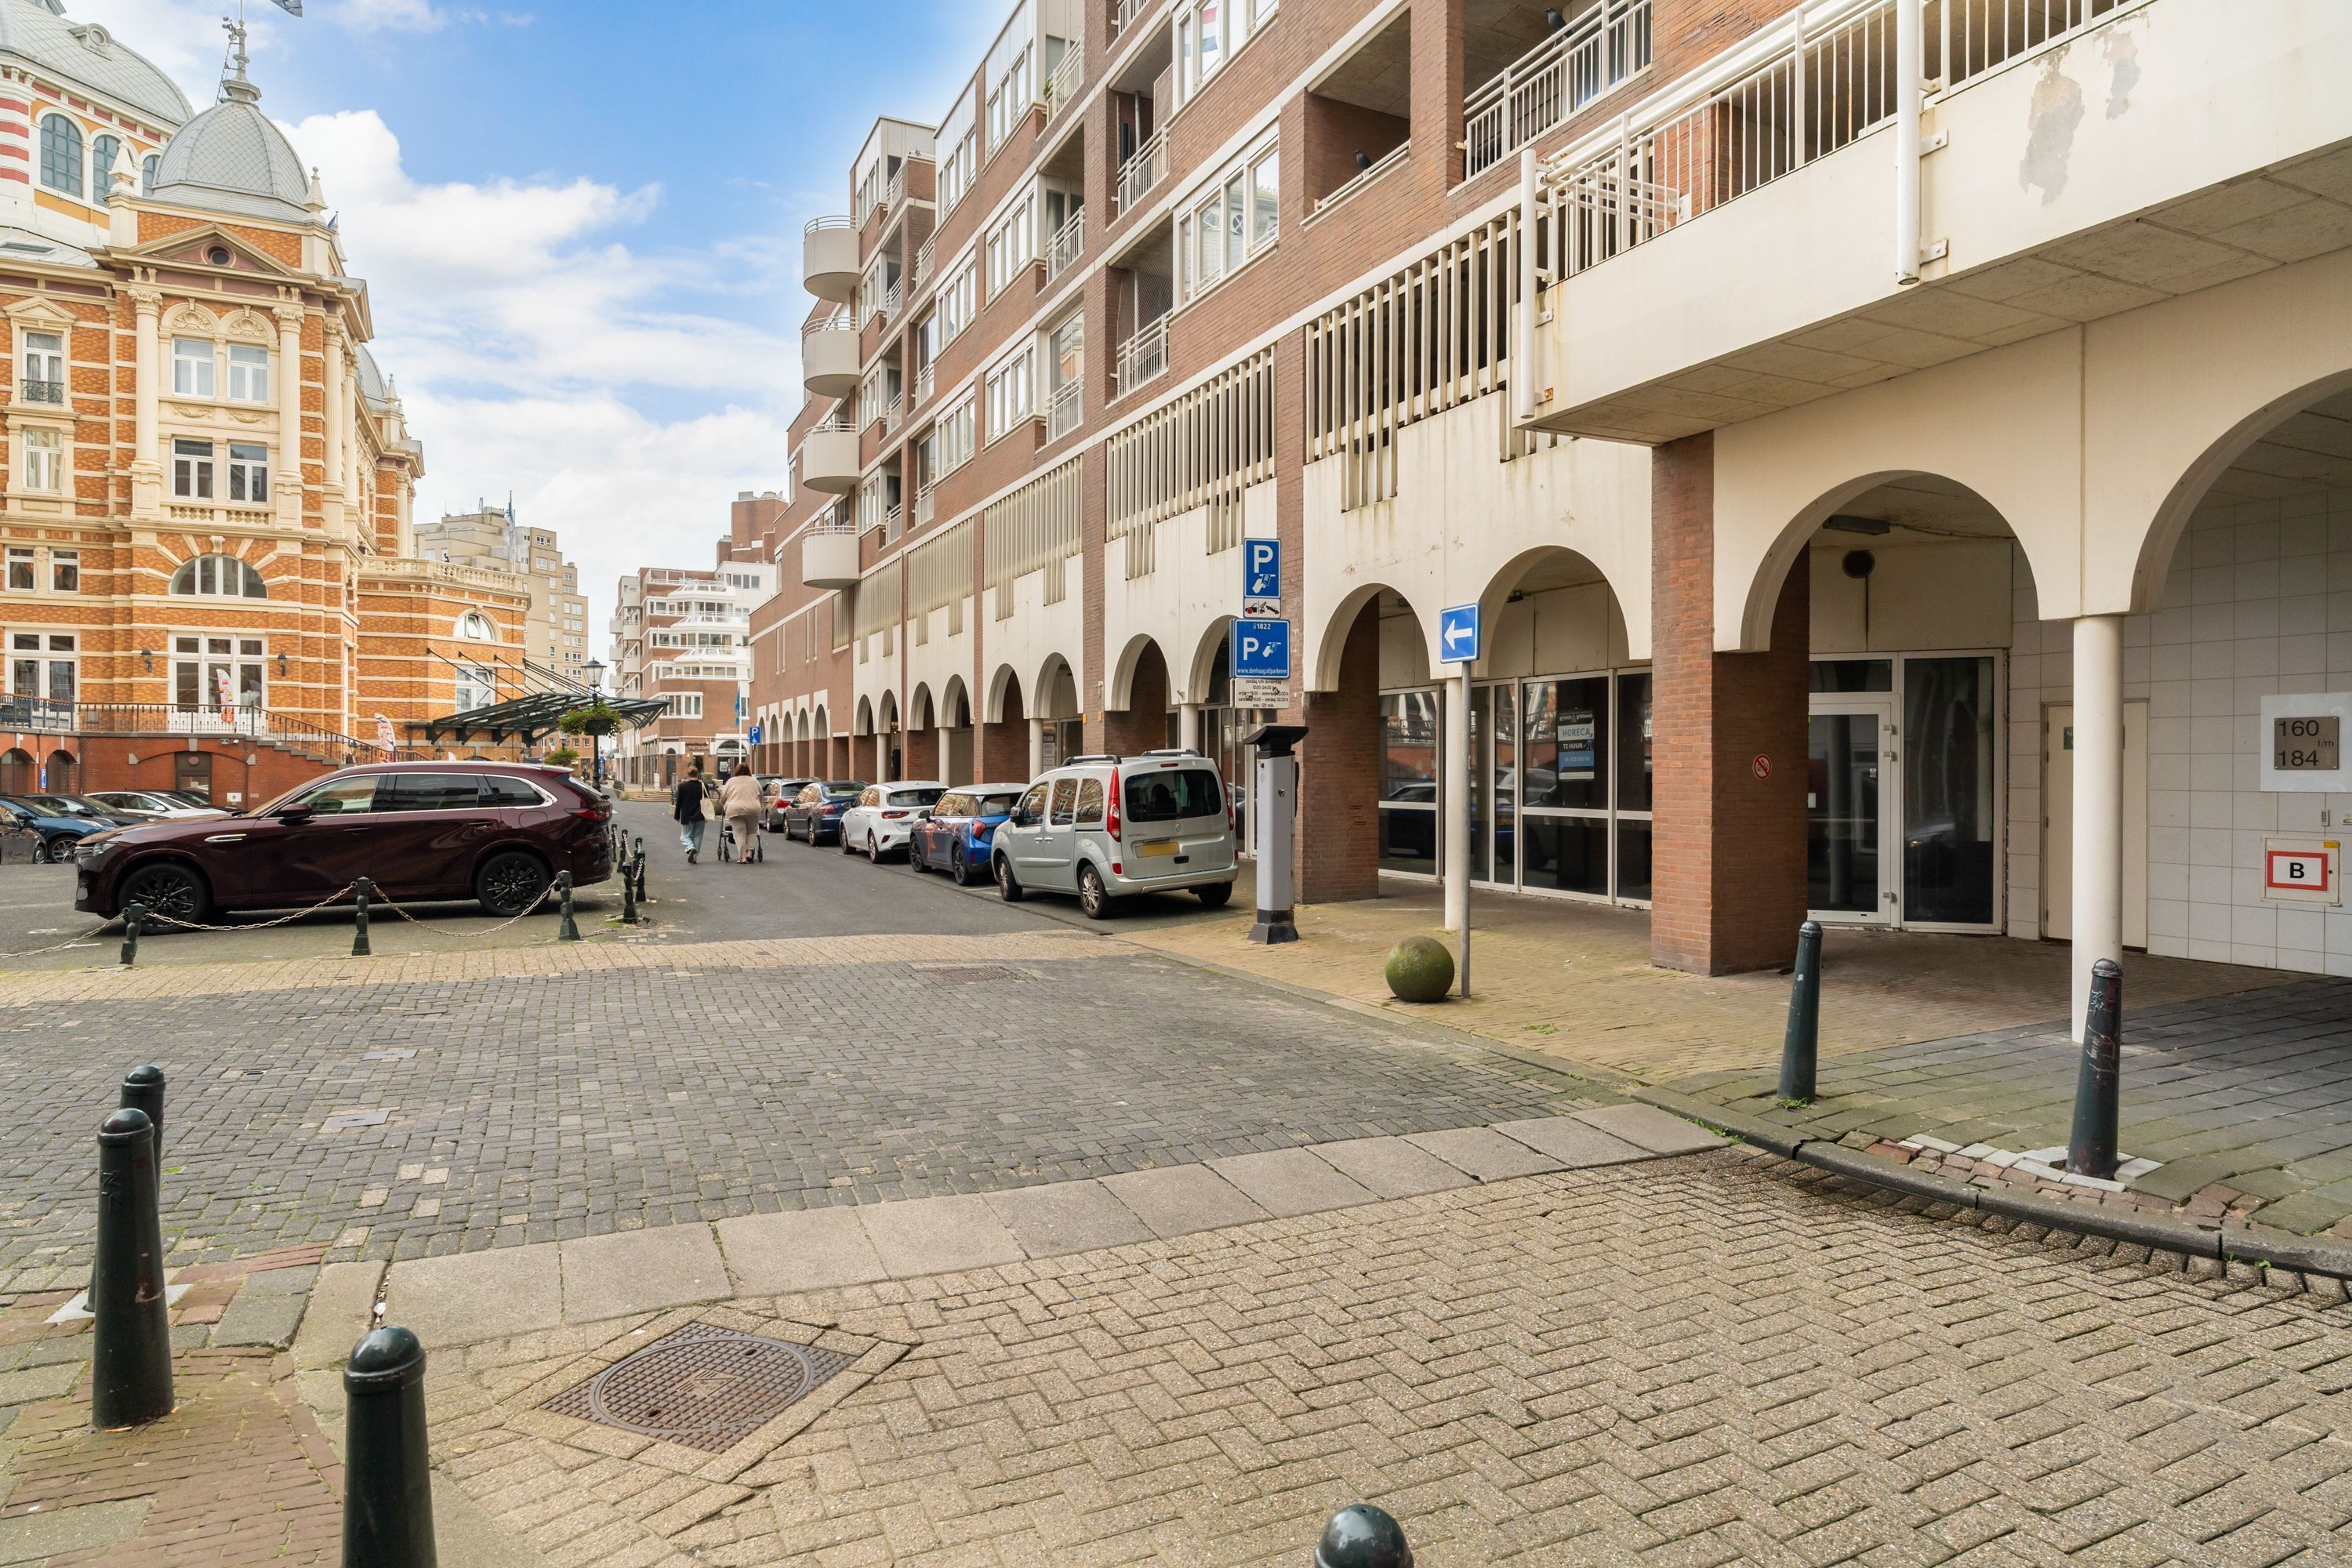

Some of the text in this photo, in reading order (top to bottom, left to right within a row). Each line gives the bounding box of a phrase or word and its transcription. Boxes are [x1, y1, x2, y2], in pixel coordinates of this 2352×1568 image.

[1254, 544, 1274, 574] P
[1243, 637, 1259, 660] P
[752, 728, 758, 736] P
[1562, 728, 1591, 738] HORECA
[2278, 720, 2320, 737] 160
[2318, 739, 2334, 748] t/m
[2278, 750, 2320, 767] 184
[2288, 862, 2306, 879] B
